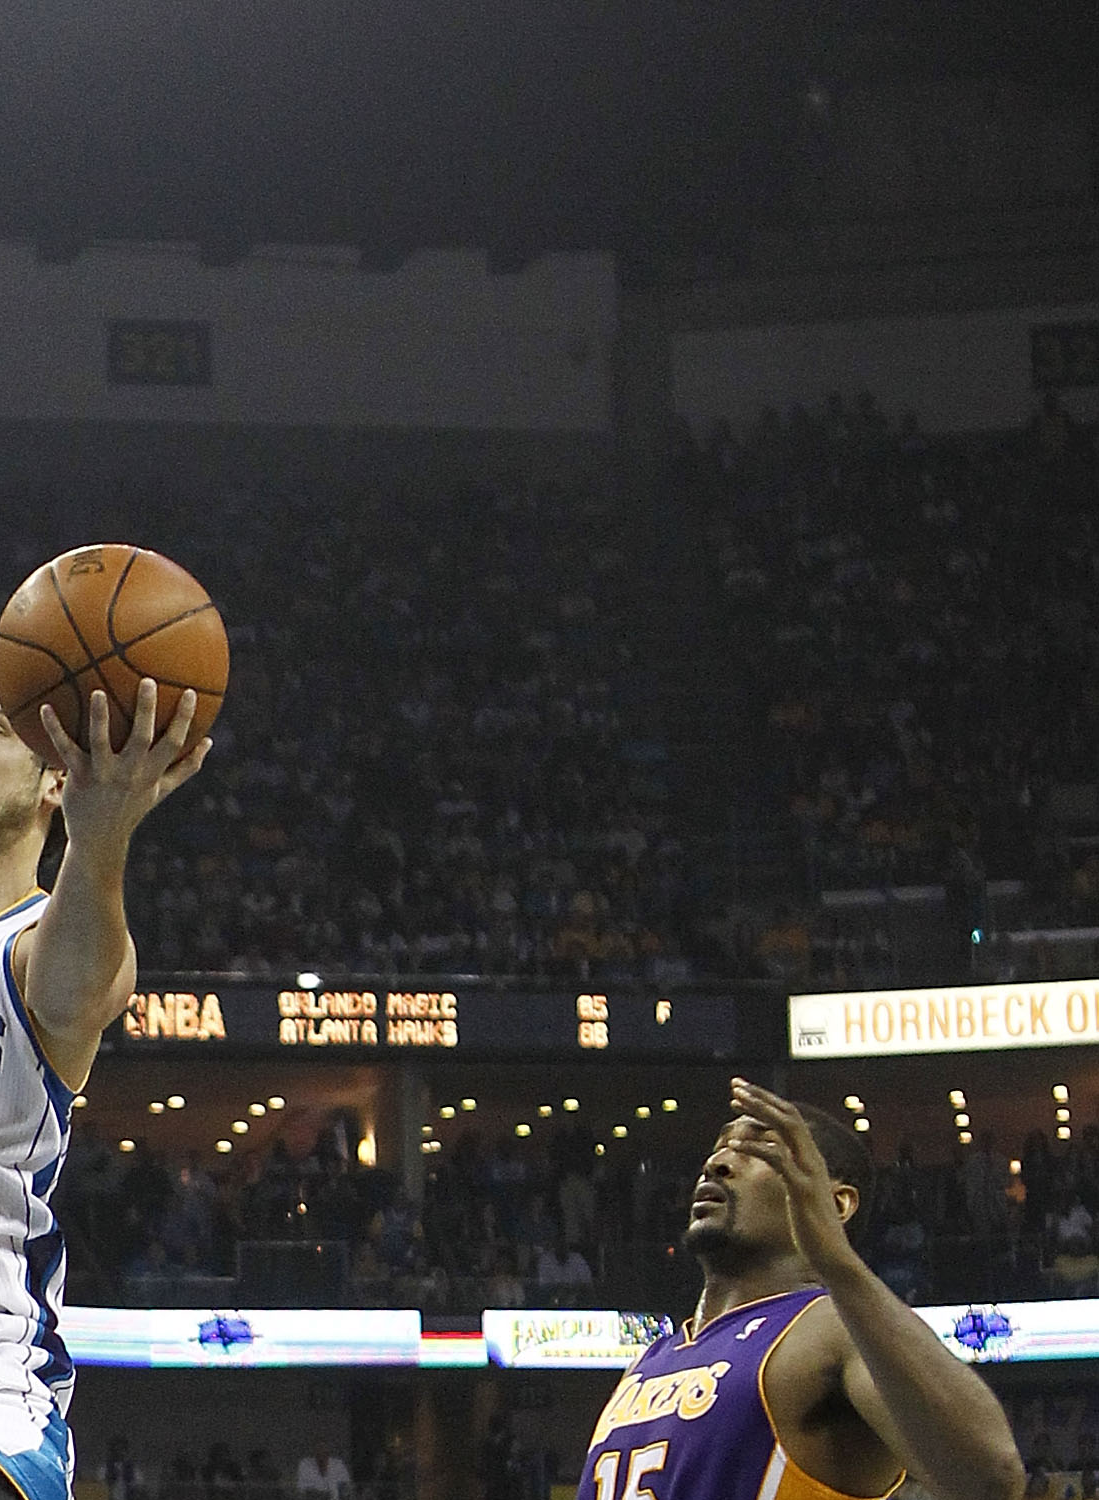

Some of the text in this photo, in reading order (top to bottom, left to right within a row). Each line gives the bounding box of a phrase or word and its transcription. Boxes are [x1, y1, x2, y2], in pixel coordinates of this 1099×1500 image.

[150, 992, 226, 1040] NBA
[279, 991, 377, 1018] ORLANDO
[387, 992, 457, 1018] MAGIC
[844, 993, 1052, 1043] HORNBECK
[279, 1018, 378, 1045] ATLANTA
[387, 1018, 458, 1047] HAWKS
